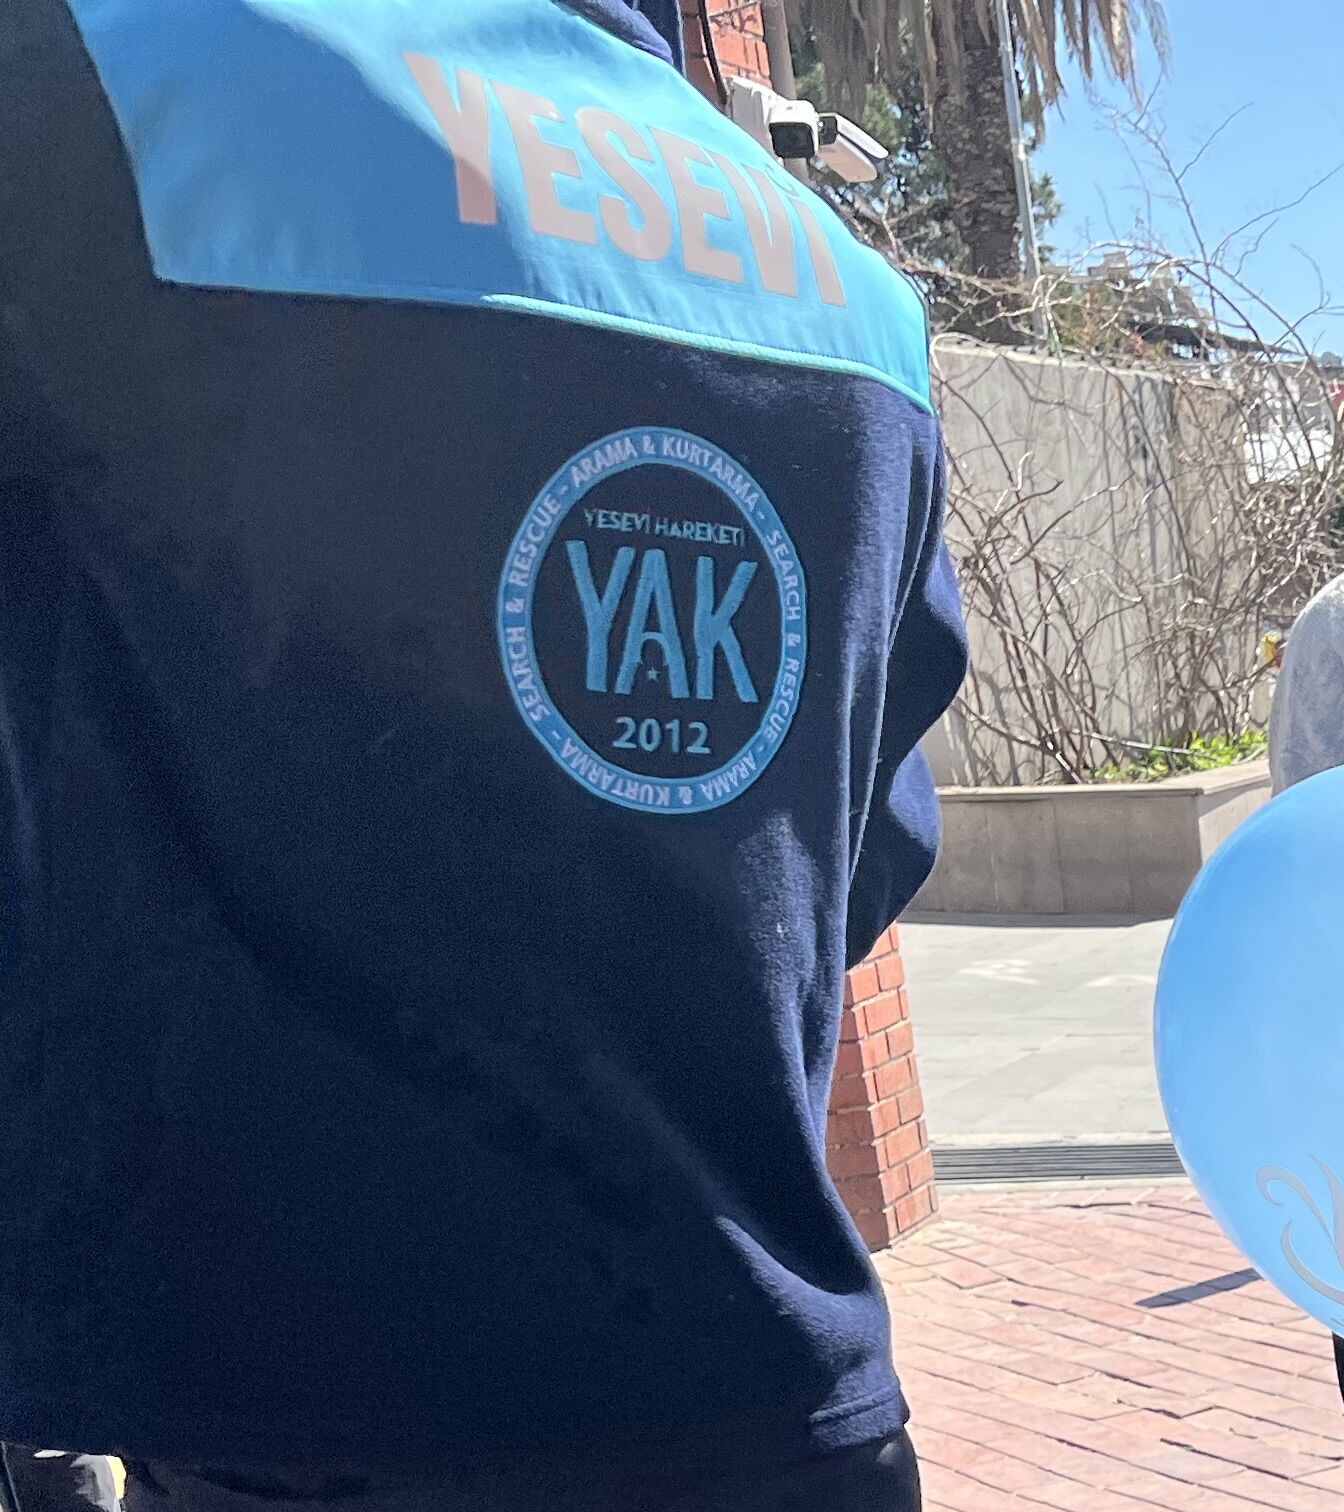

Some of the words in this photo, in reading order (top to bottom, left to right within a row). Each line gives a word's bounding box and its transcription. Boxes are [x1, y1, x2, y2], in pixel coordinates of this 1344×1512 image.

[570, 437, 637, 488] ARAMA
[662, 435, 759, 513] KURTARMA
[508, 493, 563, 587] RESCUE
[766, 529, 801, 621] SEARCH
[565, 540, 760, 704] YAK
[612, 716, 712, 755] 2012
[764, 656, 800, 741] RESCUE
[562, 736, 670, 807] KURTARMA
[701, 749, 757, 802] ARAMA
